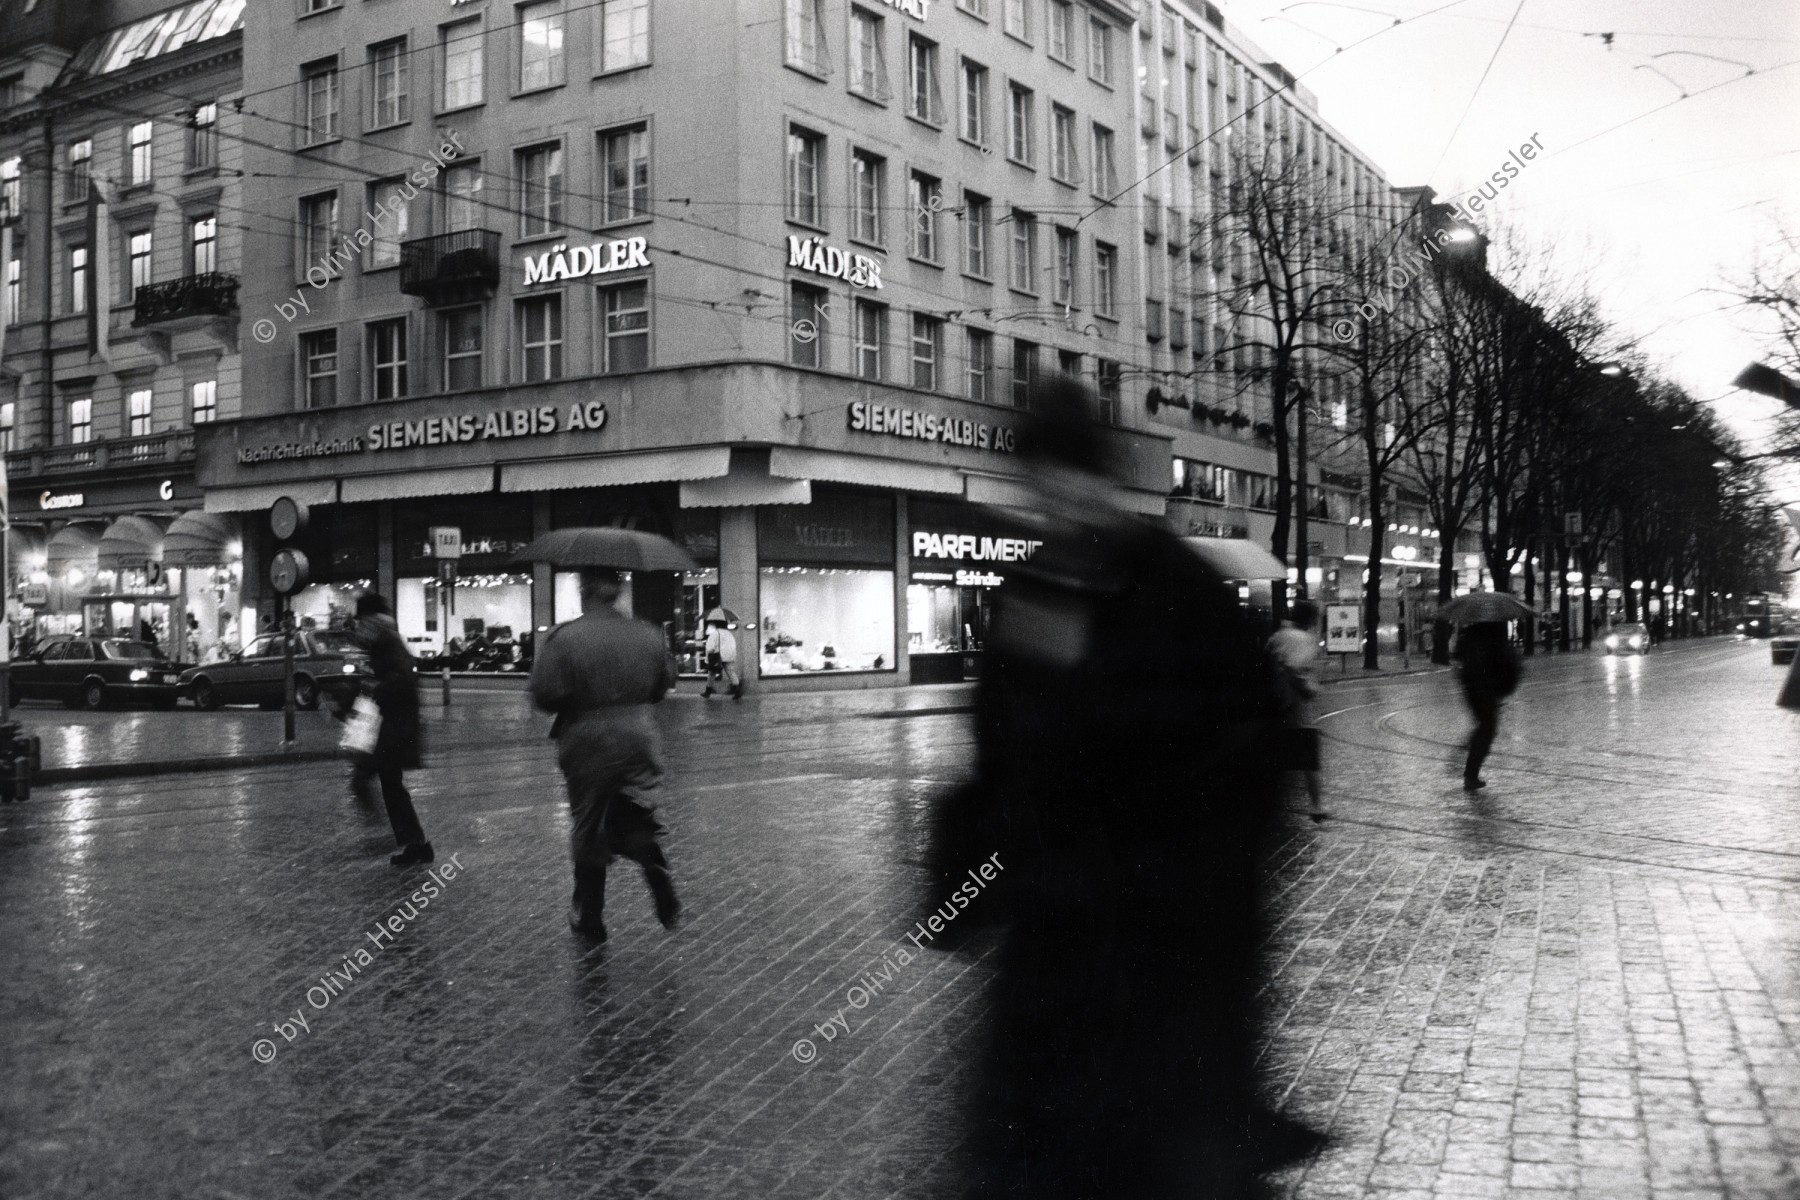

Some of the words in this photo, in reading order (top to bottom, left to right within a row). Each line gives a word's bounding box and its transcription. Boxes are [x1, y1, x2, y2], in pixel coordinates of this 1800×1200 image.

[523, 235, 651, 285] MÄDLER
[787, 234, 884, 289] MÄDLER
[236, 437, 362, 464] Nachrichtentechnik
[366, 405, 557, 451] SIEMENS-ALBIS
[565, 400, 606, 432] AG
[850, 401, 989, 448] SIEMENS-ALBIS
[994, 427, 1016, 452] AG
